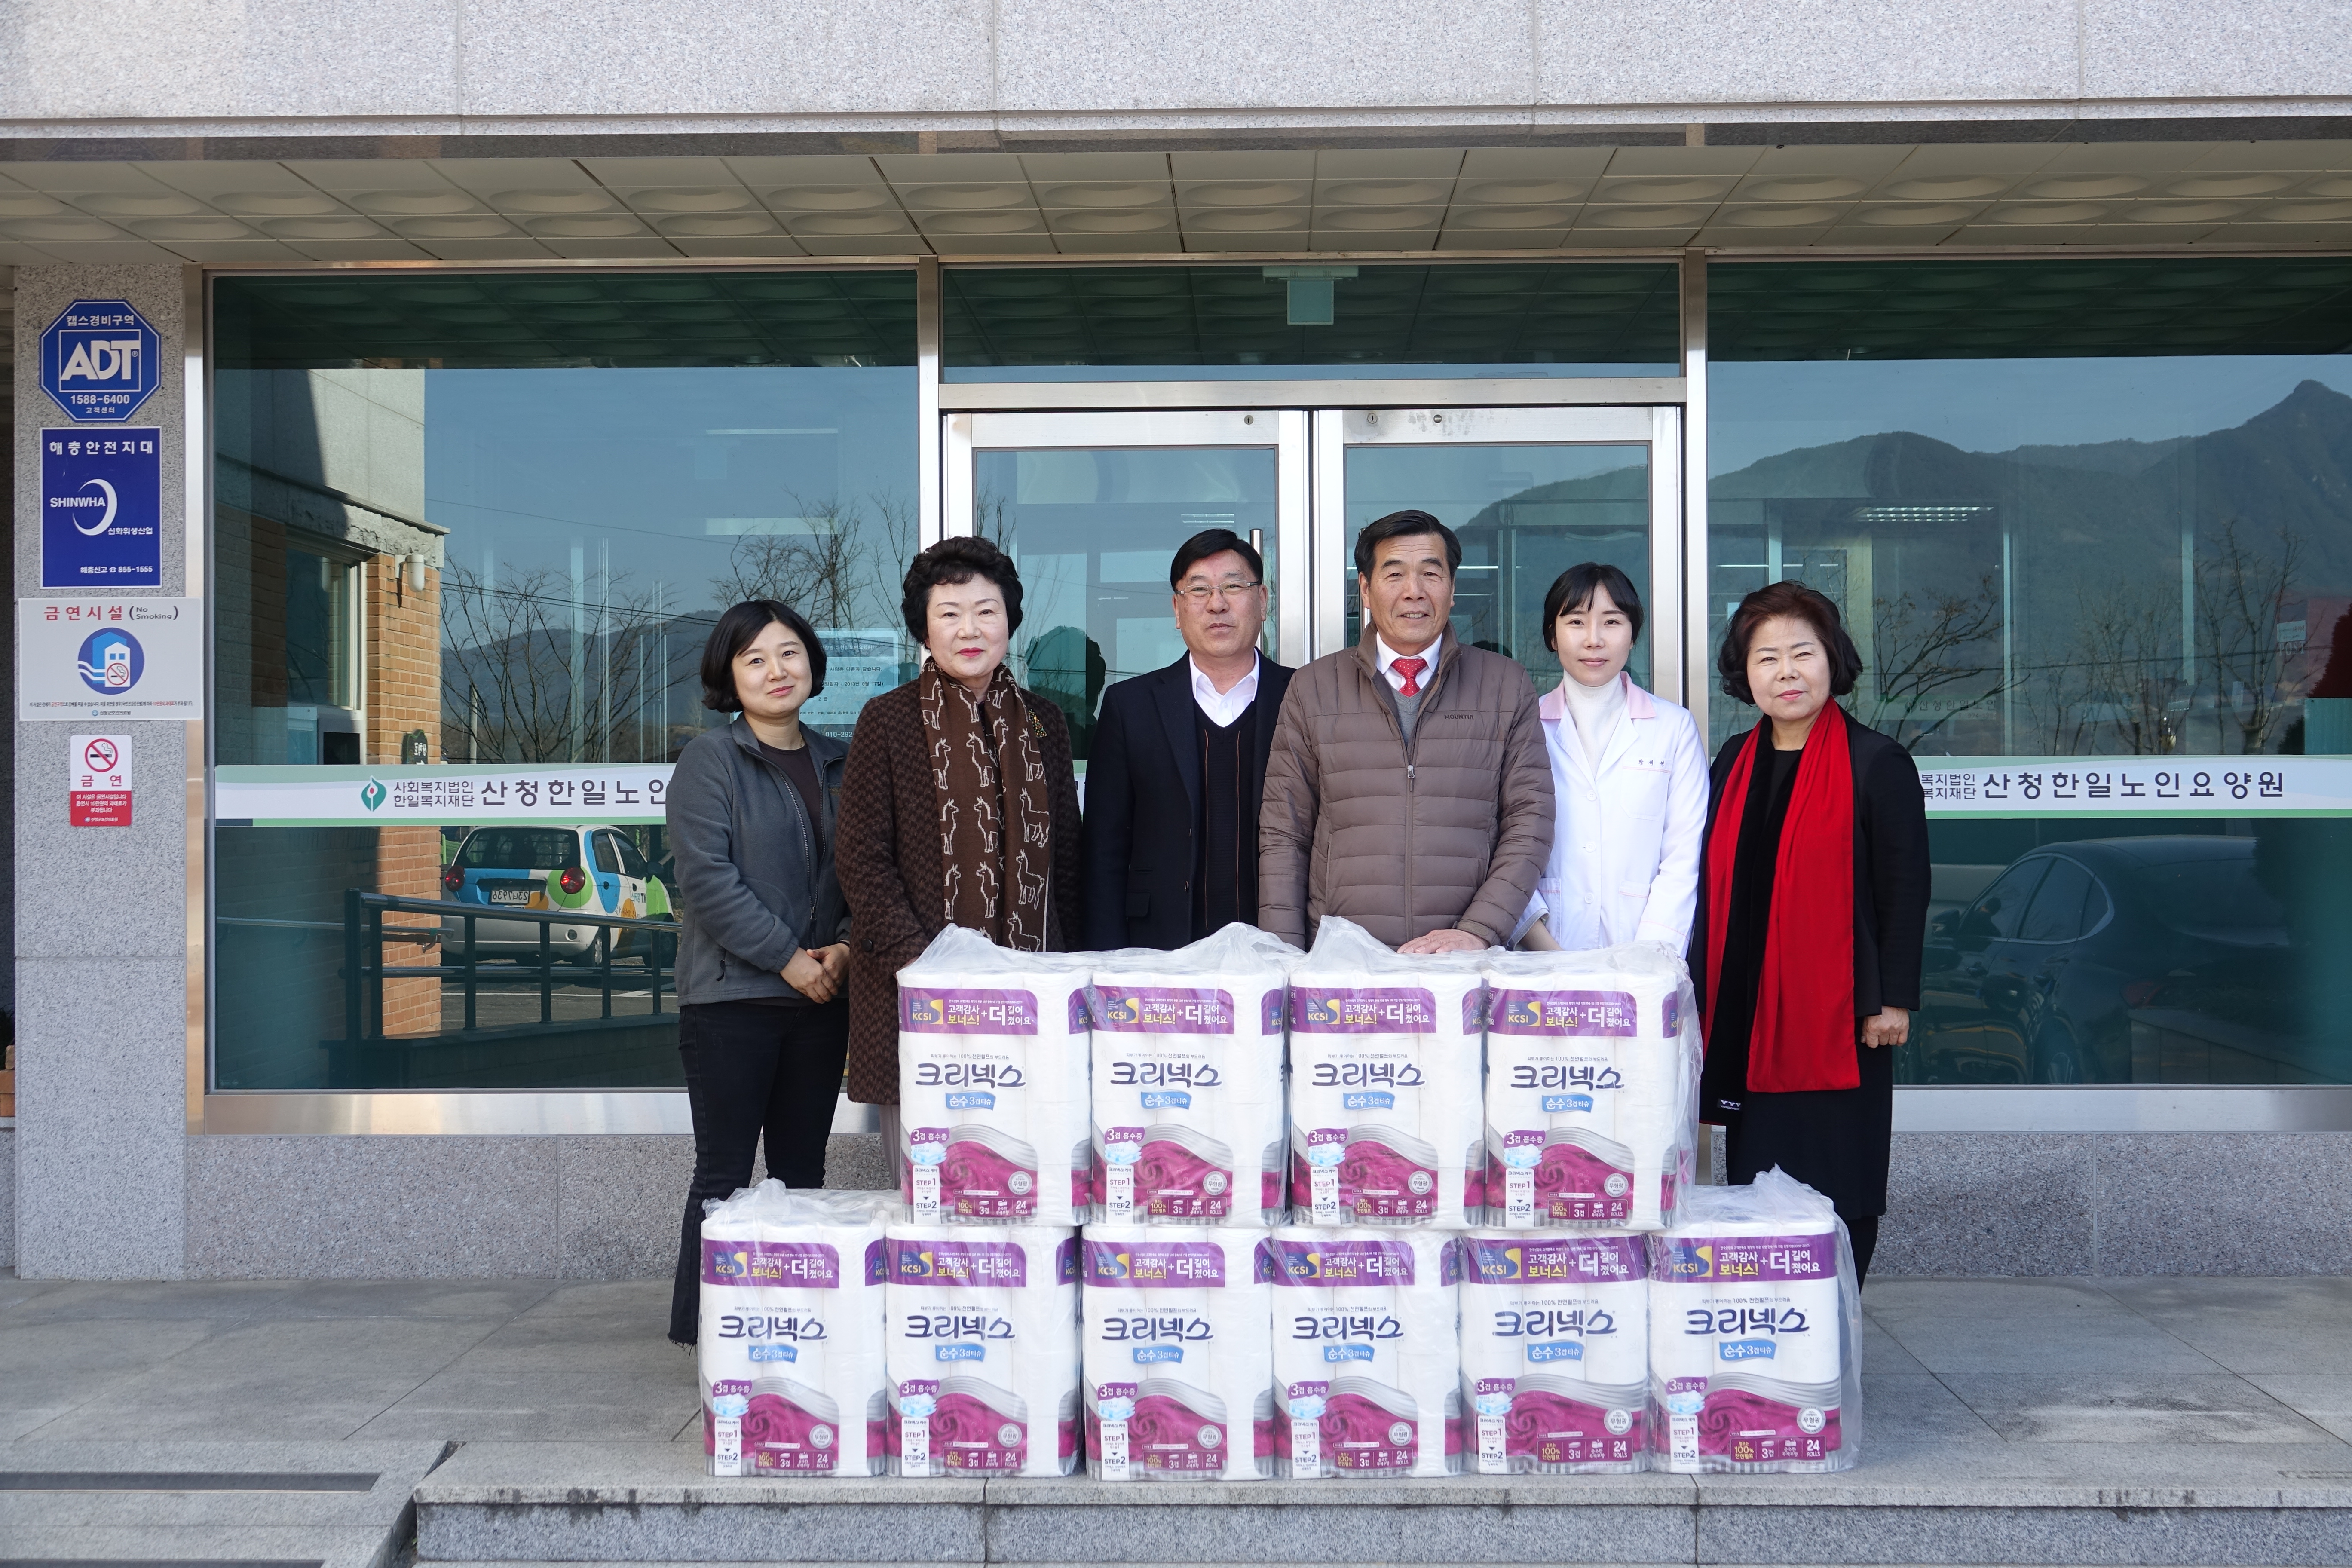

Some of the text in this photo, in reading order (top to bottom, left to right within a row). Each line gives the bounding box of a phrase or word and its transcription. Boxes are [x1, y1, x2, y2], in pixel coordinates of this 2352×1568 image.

[67, 315, 134, 327] 캡스경비구역
[61, 341, 140, 380] ADT
[70, 395, 129, 404] 1588-6400
[50, 497, 105, 508] SHINWHA
[108, 527, 153, 535] 신화위생산업
[394, 781, 474, 794] 사회복지법인
[1983, 772, 2284, 800] 산청한일노인요양원
[394, 794, 474, 807] 한일복지재단
[948, 1005, 980, 1015] 고객감사
[1143, 1004, 1175, 1014] 고객감사
[1185, 1004, 1219, 1025] 더 길어
[1344, 1004, 1377, 1014] 고객감사
[1387, 1004, 1421, 1024] 더 길어
[1546, 1007, 1577, 1017] 고객감사
[912, 1012, 931, 1021] KCSI
[947, 1015, 980, 1025] 보너스!
[989, 1005, 1023, 1026] 더 길어
[1007, 1016, 1031, 1025] 졌어요
[1108, 1011, 1127, 1020] KCSI
[1143, 1014, 1176, 1024] 보너스!
[1204, 1014, 1227, 1024] 졌어요
[1308, 1012, 1328, 1020] KCSI
[1344, 1014, 1377, 1025] 보너스!
[1405, 1014, 1429, 1023] 졌어요
[1508, 1014, 1528, 1023] KCSI
[1588, 1007, 1622, 1027] 더 길어
[1545, 1017, 1577, 1027] 보너스!
[1606, 1017, 1631, 1027] 졌어요
[915, 1063, 1026, 1087] 크리넥스
[1110, 1062, 1222, 1087] 크리넥스
[1312, 1063, 1425, 1087] 크리넥스
[1510, 1066, 1625, 1090] 크리넥스
[949, 1096, 968, 1108] 순수
[1145, 1096, 1163, 1106] 순수
[1348, 1096, 1366, 1107] 순수
[1546, 1098, 1565, 1110] 순수
[1107, 1129, 1120, 1140] 3겹
[1506, 1132, 1521, 1144] 3겹
[1611, 1202, 1622, 1211] 24
[751, 1257, 782, 1267] 고객감사
[937, 1257, 968, 1267] 고객감사
[1324, 1257, 1356, 1267] 고객감사
[1528, 1253, 1566, 1265] 고객감사
[1719, 1252, 1758, 1263] 고객감사
[1771, 1250, 1810, 1275] 더 길어
[791, 1259, 825, 1279] 더 길어
[901, 1265, 921, 1273] KCSI
[979, 1258, 1011, 1278] 더 길어
[1134, 1259, 1166, 1268] 고객감사
[1176, 1258, 1210, 1279] 더 길어
[1366, 1257, 1399, 1277] 더 길어
[1579, 1252, 1619, 1277] 더 길어
[1673, 1264, 1698, 1273] KCSI
[1792, 1262, 1821, 1274] 졌어요
[716, 1265, 735, 1274] KCSI
[751, 1267, 782, 1278] 보너스!
[809, 1269, 833, 1279] 졌어요
[937, 1268, 969, 1278] 보너스!
[996, 1268, 1020, 1277] 졌어요
[1098, 1267, 1117, 1275] KCSI
[1134, 1268, 1167, 1279] 보너스!
[1194, 1268, 1219, 1278] 졌어요
[1288, 1266, 1308, 1274] KCSI
[1324, 1267, 1357, 1278] 보너스!
[1384, 1266, 1408, 1277] 졌어요
[1482, 1265, 1507, 1275] KCSI
[1528, 1265, 1567, 1278] 보너스!
[1600, 1264, 1629, 1276] 졌어요
[1719, 1263, 1759, 1277] 보너스!
[1493, 1308, 1618, 1337] 크리넥스
[1684, 1307, 1810, 1335] 크리넥스
[718, 1315, 828, 1341] 크리넥스
[904, 1314, 1016, 1340] 크리넥스
[1102, 1317, 1214, 1341] 크리넥스
[1292, 1316, 1404, 1341] 크리넥스
[752, 1348, 770, 1360] 순수
[940, 1347, 958, 1359] 순수
[1136, 1349, 1156, 1360] 순수
[1328, 1348, 1346, 1359] 순수
[1532, 1346, 1553, 1360] 순수
[1724, 1344, 1746, 1356] 순수
[1477, 1380, 1491, 1392] 3겹
[1614, 1441, 1626, 1452] 24
